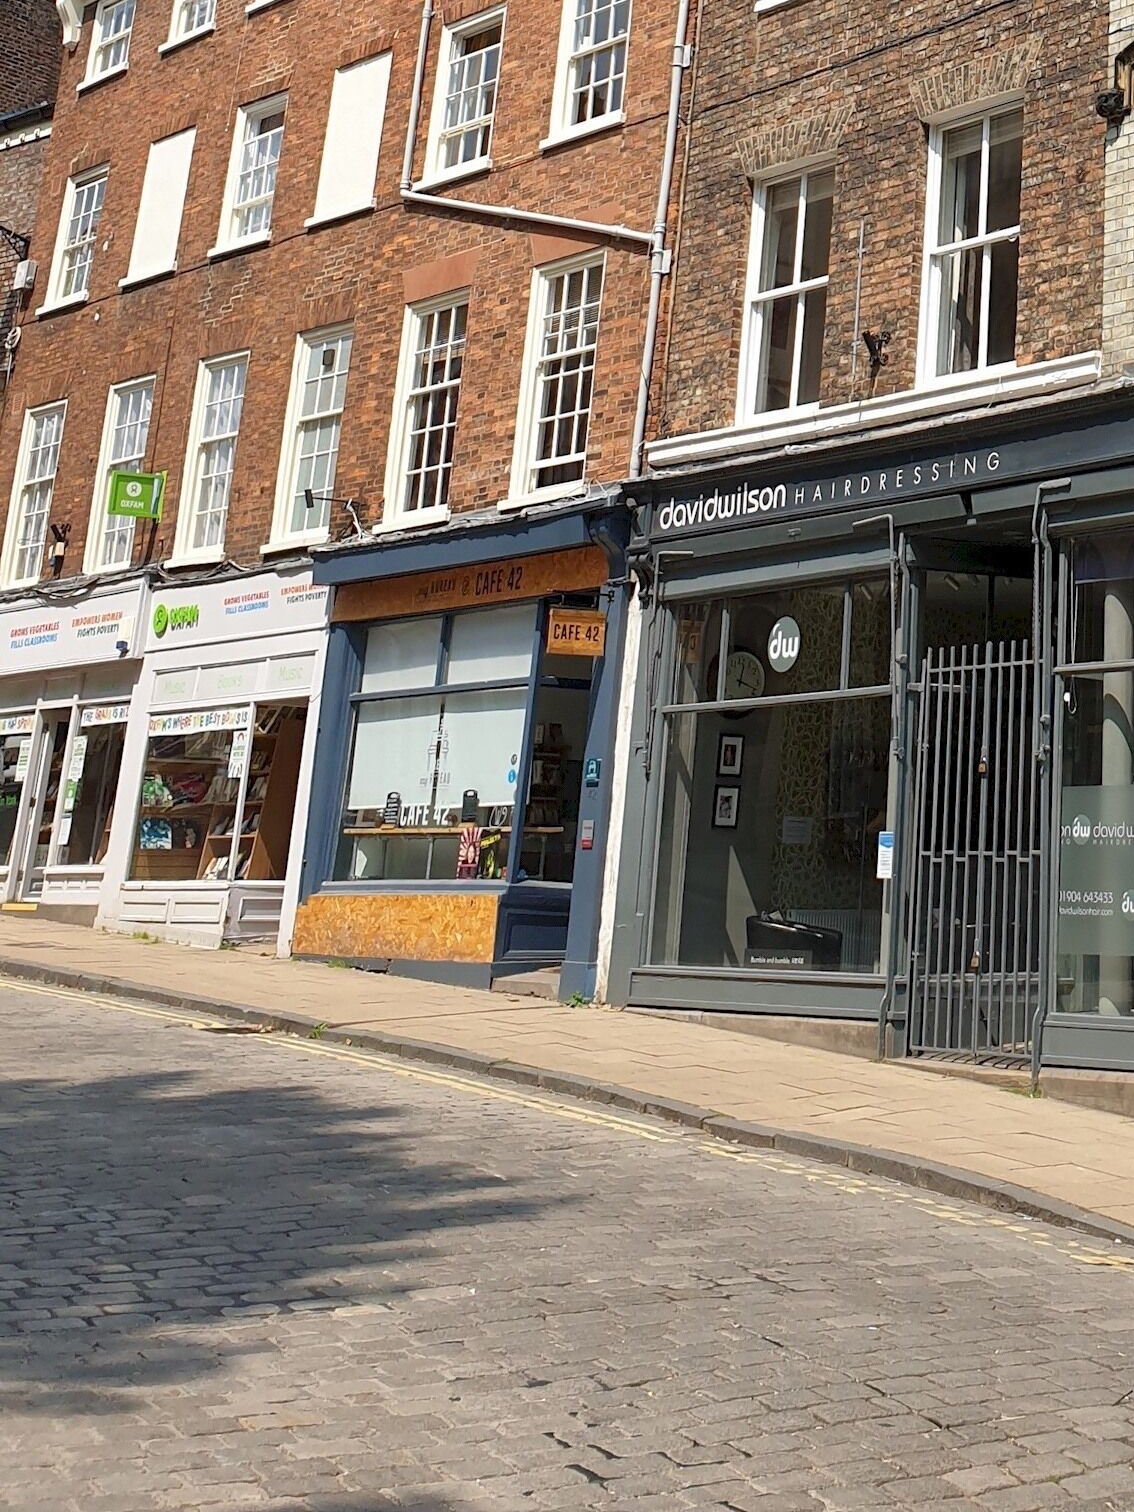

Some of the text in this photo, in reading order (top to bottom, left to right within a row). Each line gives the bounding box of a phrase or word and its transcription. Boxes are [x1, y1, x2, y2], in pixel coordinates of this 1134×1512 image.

[659, 451, 1000, 529] davidwilson HAIRDRESSING
[120, 499, 144, 509] OXFAM
[475, 569, 503, 596] CAFE
[507, 566, 523, 591] 42
[241, 591, 270, 603] VEGETABLES
[286, 590, 328, 605] FIGHTS POVERTY
[238, 601, 269, 613] CLASSROOMS
[29, 621, 60, 635] VEGETABLES
[76, 627, 96, 639] FIGHTS
[553, 623, 600, 641] CAFE 42
[24, 632, 58, 646] CLASSROOMS
[205, 712, 220, 727] BEST
[399, 805, 430, 827] CAFE
[433, 805, 451, 827] 42
[1082, 891, 1114, 904] 643433
